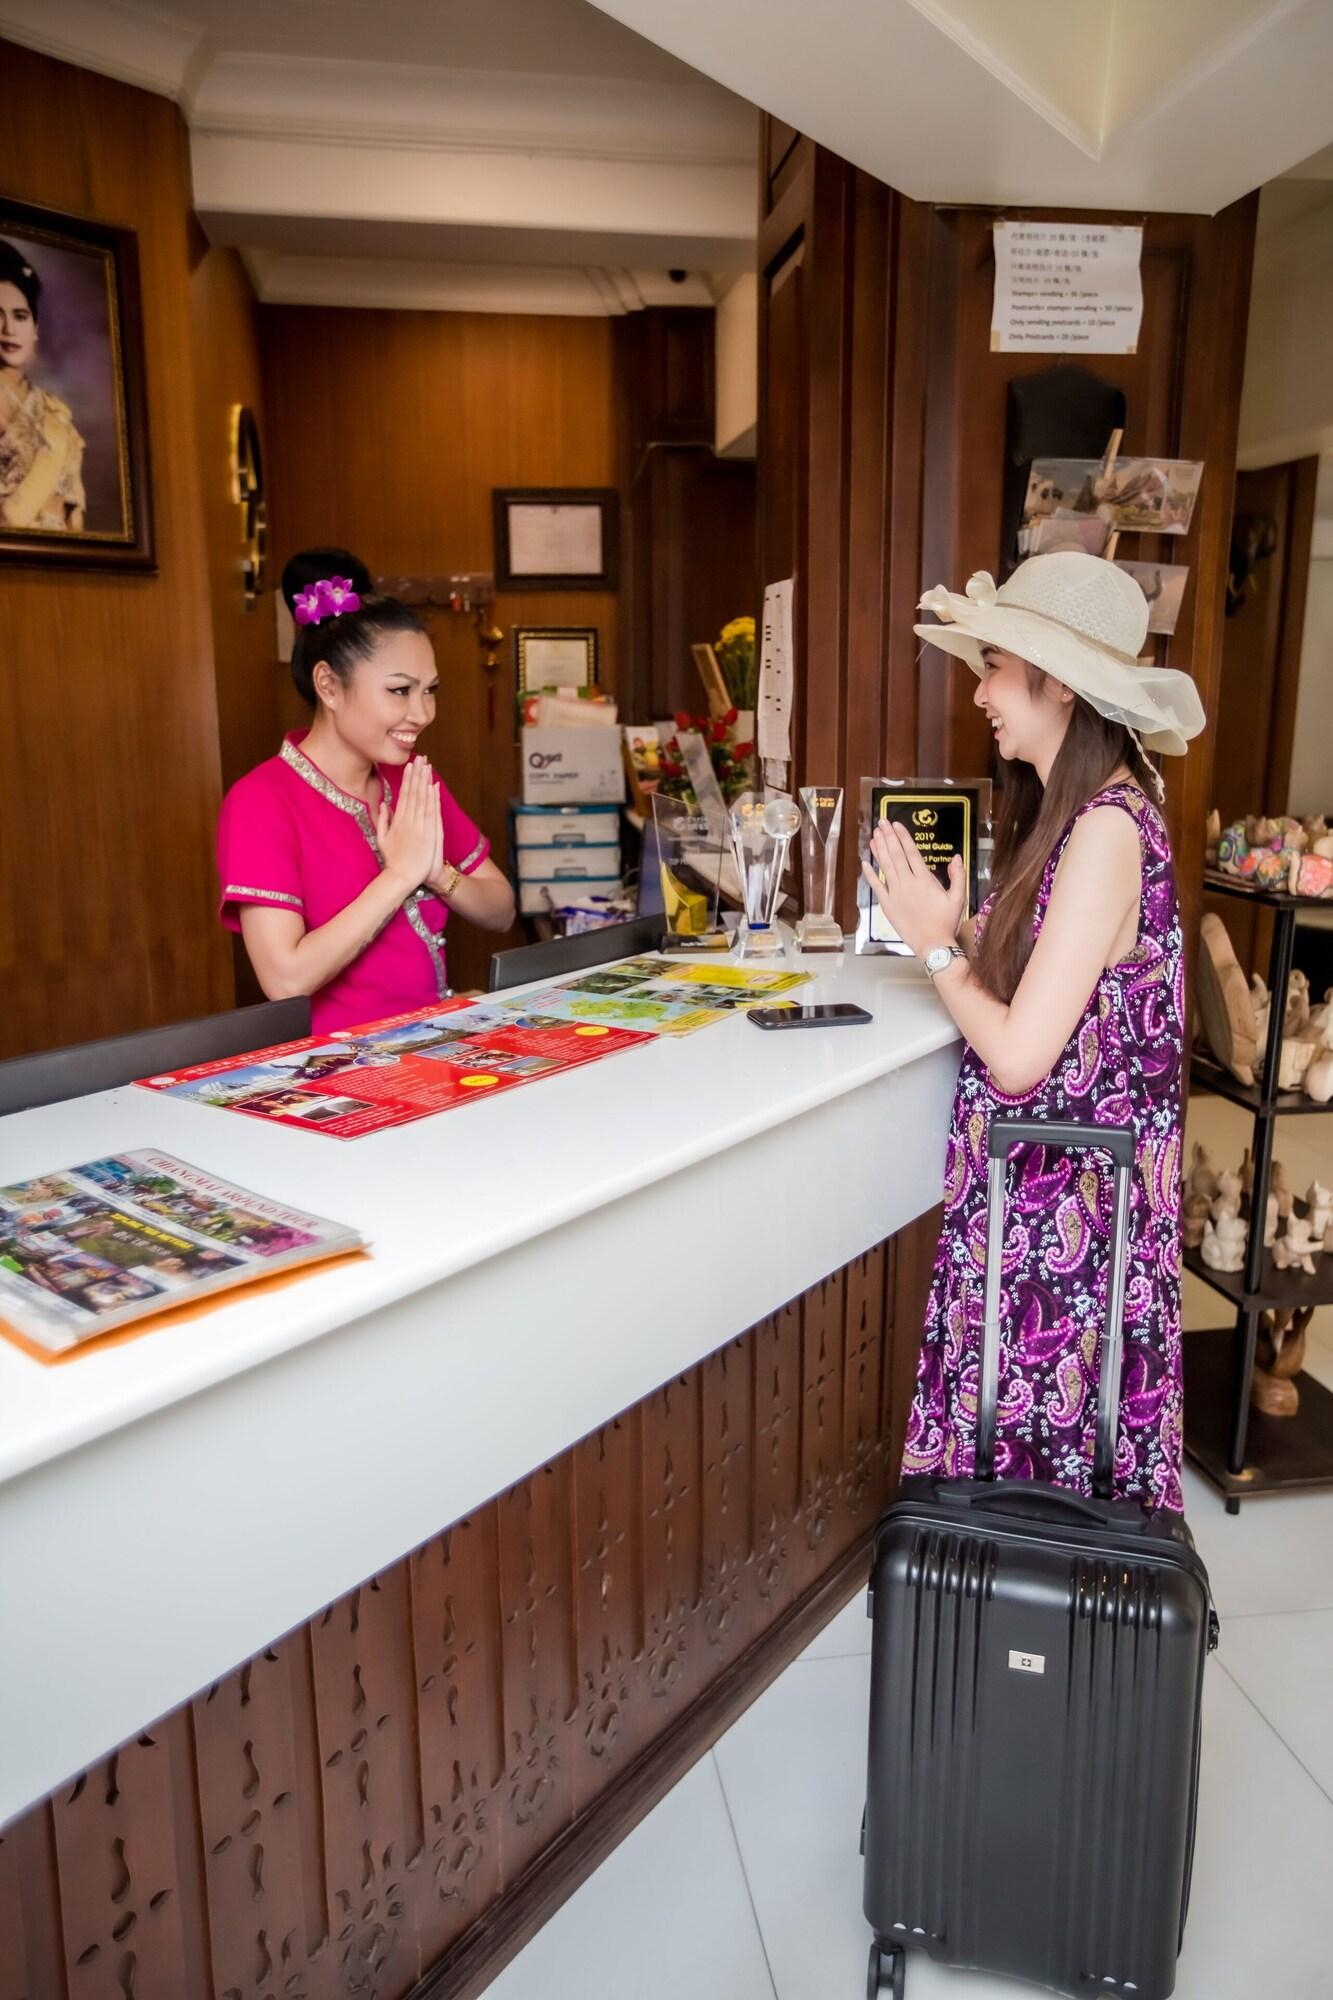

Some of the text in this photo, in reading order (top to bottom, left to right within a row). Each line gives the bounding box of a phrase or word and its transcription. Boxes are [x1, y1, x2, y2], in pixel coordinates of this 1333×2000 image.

[1039, 290, 1064, 298] sending
[1026, 319, 1050, 327] sending
[1051, 319, 1081, 327] postcards
[1008, 333, 1024, 341] Only
[914, 832, 935, 841] 2019
[932, 842, 953, 850] Guide
[928, 855, 952, 863] Partne
